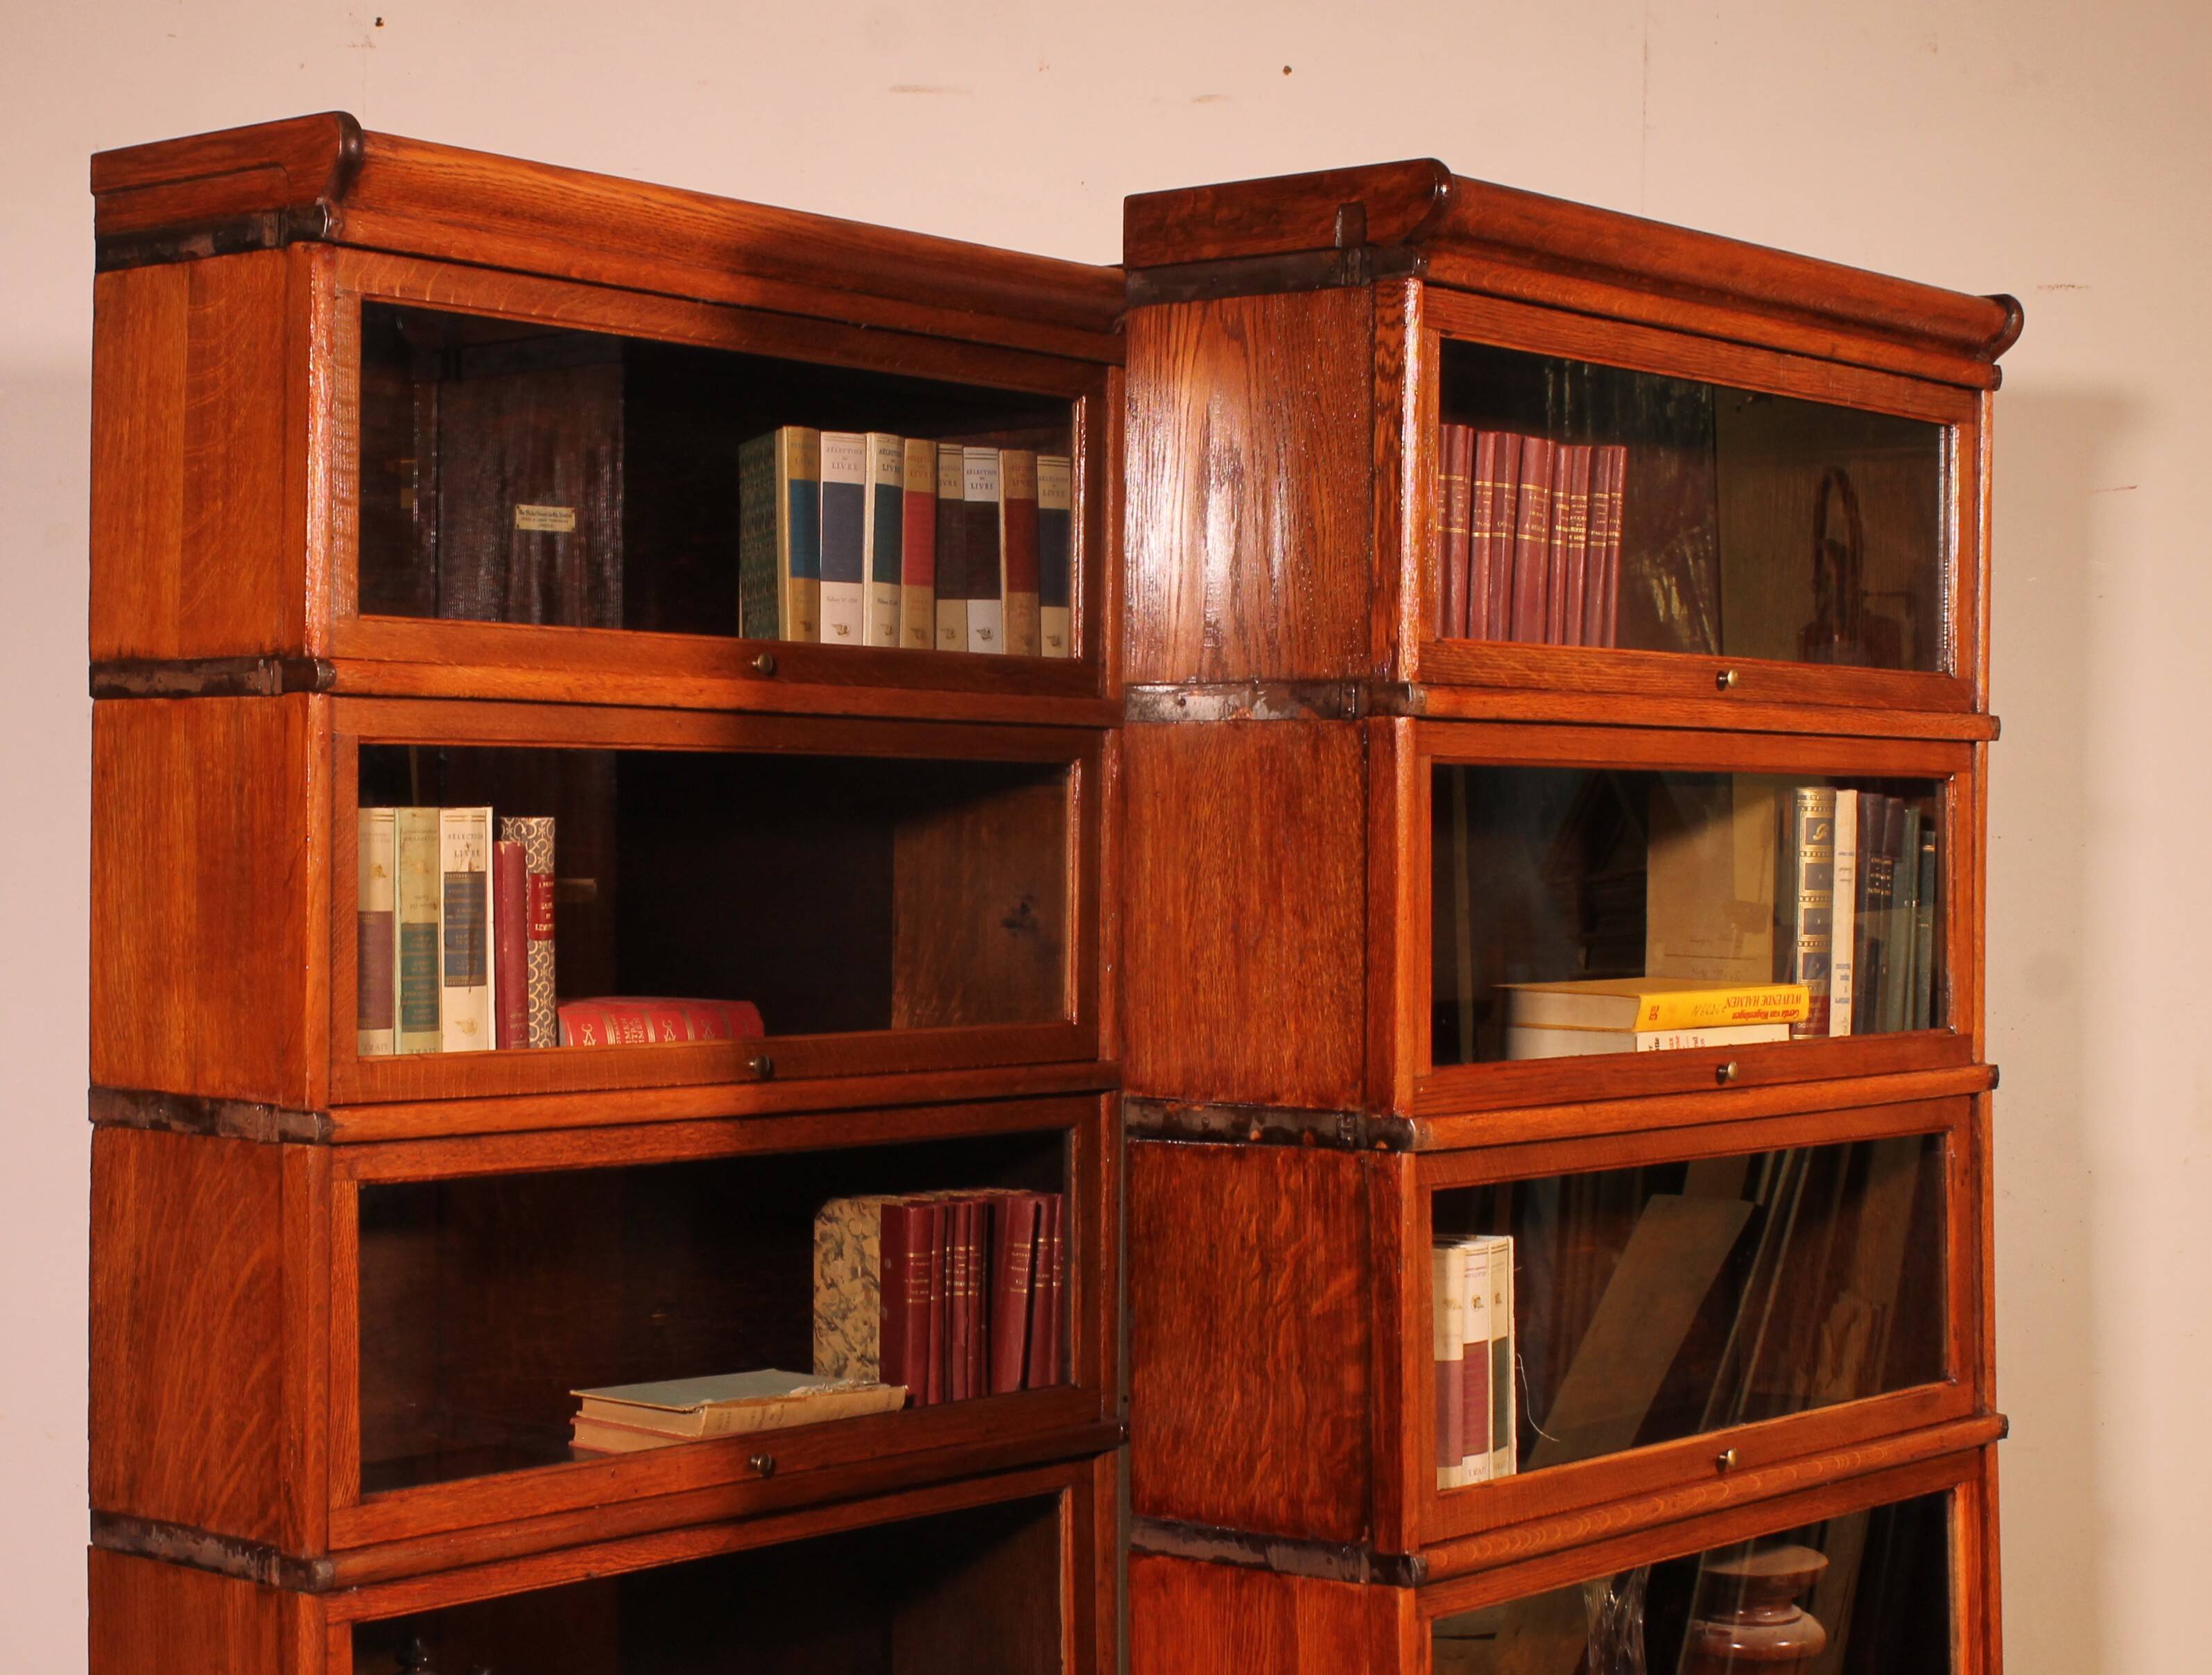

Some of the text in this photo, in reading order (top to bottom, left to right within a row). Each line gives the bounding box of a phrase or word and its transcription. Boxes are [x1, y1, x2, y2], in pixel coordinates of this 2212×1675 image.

[831, 462, 859, 472] LIVRE
[971, 482, 993, 491] LIVRE
[1727, 993, 1801, 1008] WUIVENDE HALMEN
[1731, 1009, 1769, 1022] Wageningen
[1770, 1010, 1781, 1019] van
[1781, 1010, 1799, 1020] Gerda
